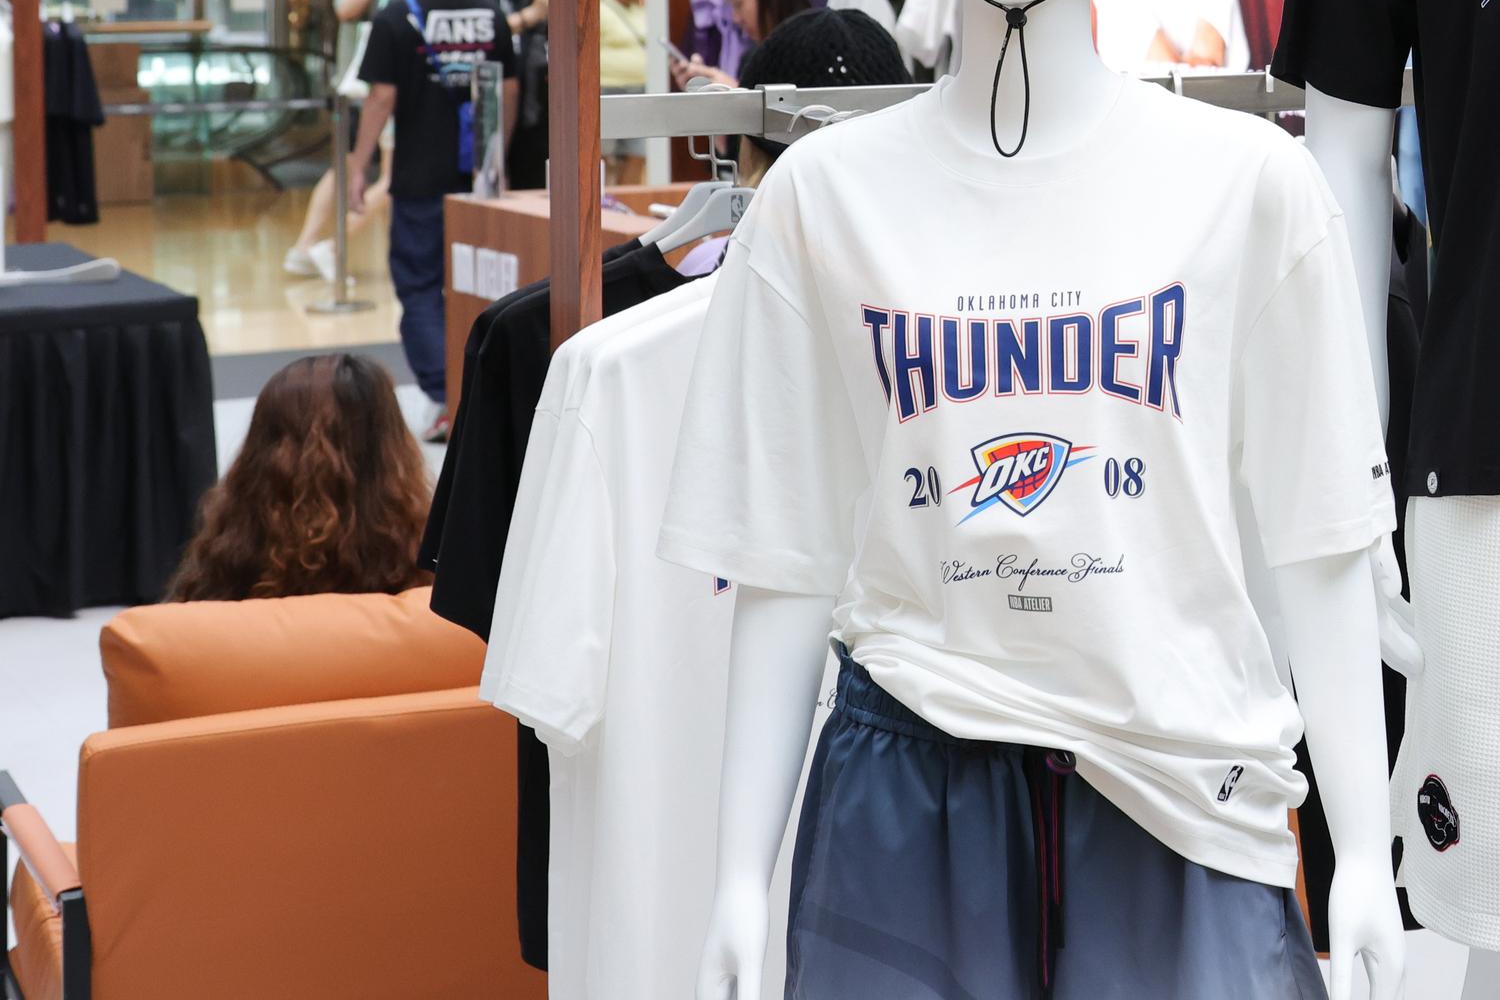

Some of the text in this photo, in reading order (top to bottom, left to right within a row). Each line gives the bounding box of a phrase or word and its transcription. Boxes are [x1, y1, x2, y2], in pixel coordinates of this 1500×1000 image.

[956, 290, 1082, 312] OKLAHOMA CITY
[861, 280, 1187, 424] THUNDER
[903, 465, 943, 509] 20
[1103, 456, 1147, 500] 08
[1371, 464, 1384, 480] NBA
[995, 554, 1068, 592] Conference
[1067, 552, 1125, 583] Finals
[1024, 598, 1050, 611] ATELIER
